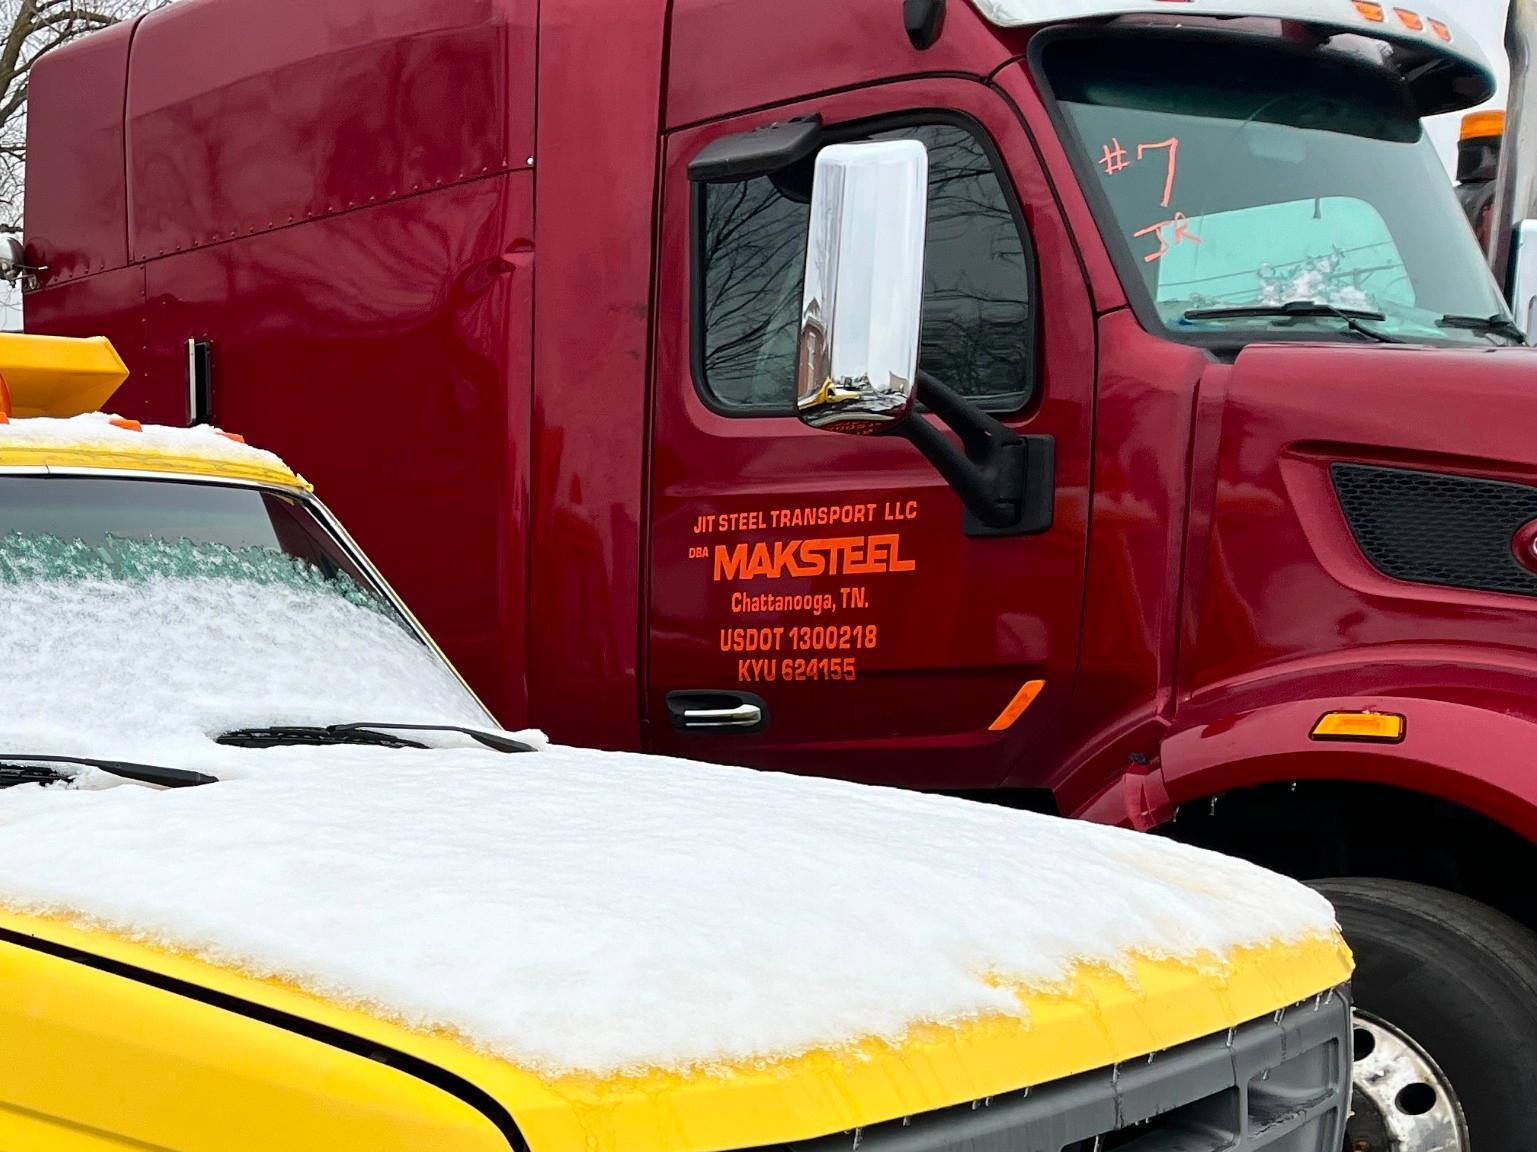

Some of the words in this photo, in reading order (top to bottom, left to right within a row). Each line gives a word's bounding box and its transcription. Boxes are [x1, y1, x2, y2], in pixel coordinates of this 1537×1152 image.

[1098, 137, 1179, 207] #7
[693, 515, 716, 534] JIT
[719, 511, 767, 532] STEEL
[770, 503, 875, 529] TRANSPORT
[884, 500, 918, 521] LLC
[688, 546, 710, 560] DBA
[713, 533, 917, 581] MAKSTEEL
[730, 591, 837, 615] Chattanooga,
[840, 586, 870, 610] TN.
[720, 627, 785, 652] USDOT
[788, 624, 878, 650] 1300218
[738, 658, 777, 683] KYU
[781, 657, 856, 682] 624155
